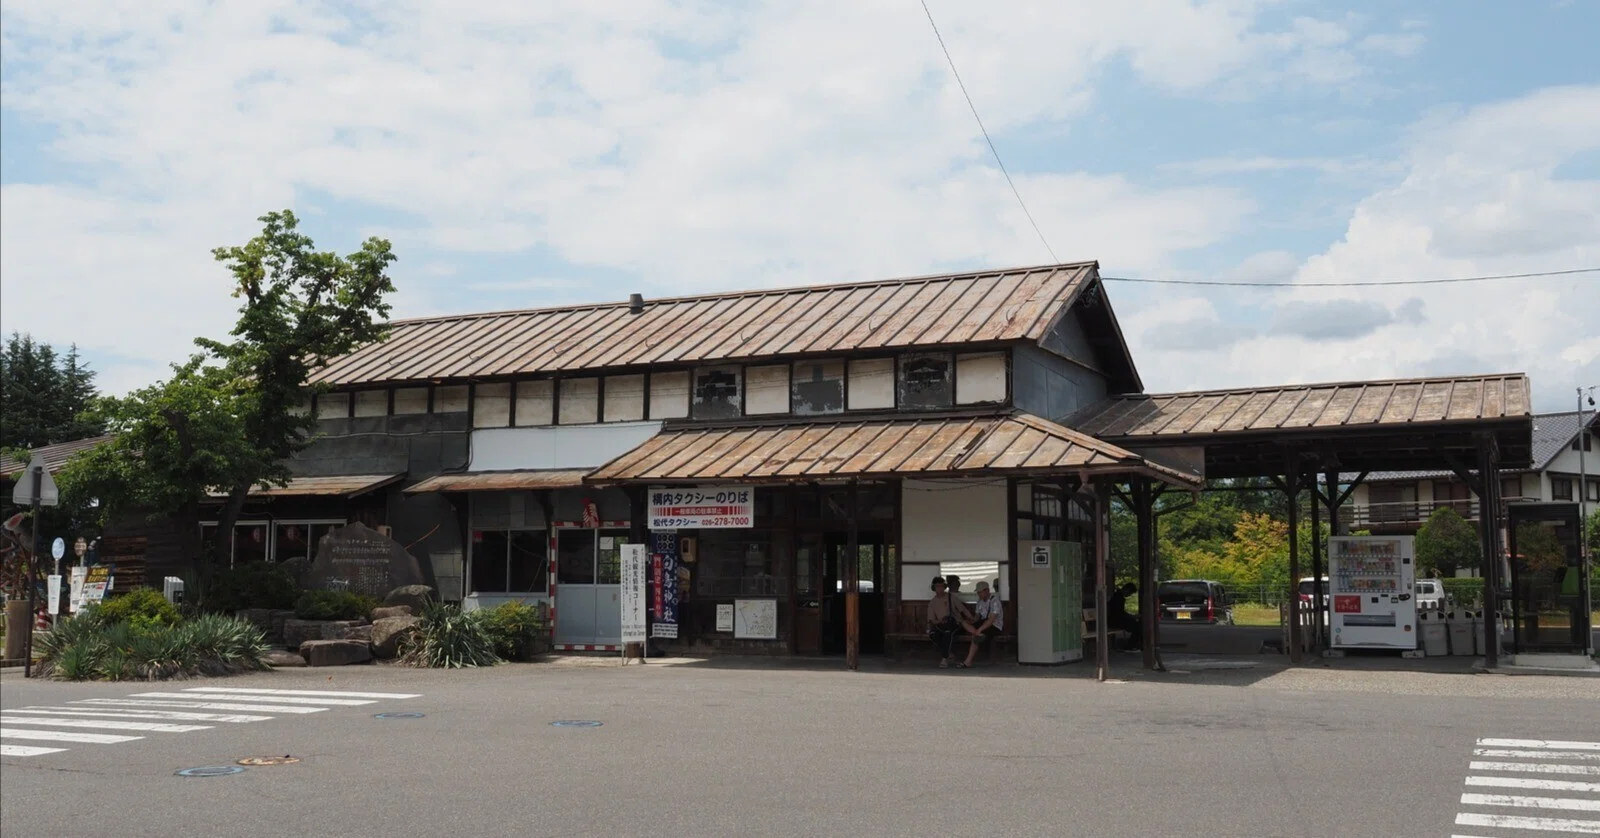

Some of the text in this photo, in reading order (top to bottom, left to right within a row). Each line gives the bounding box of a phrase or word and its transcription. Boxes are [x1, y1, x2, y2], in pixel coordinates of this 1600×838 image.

[653, 490, 749, 506] 構内タクシーのりば
[653, 517, 749, 527] 松代タクシー 026-278-7000
